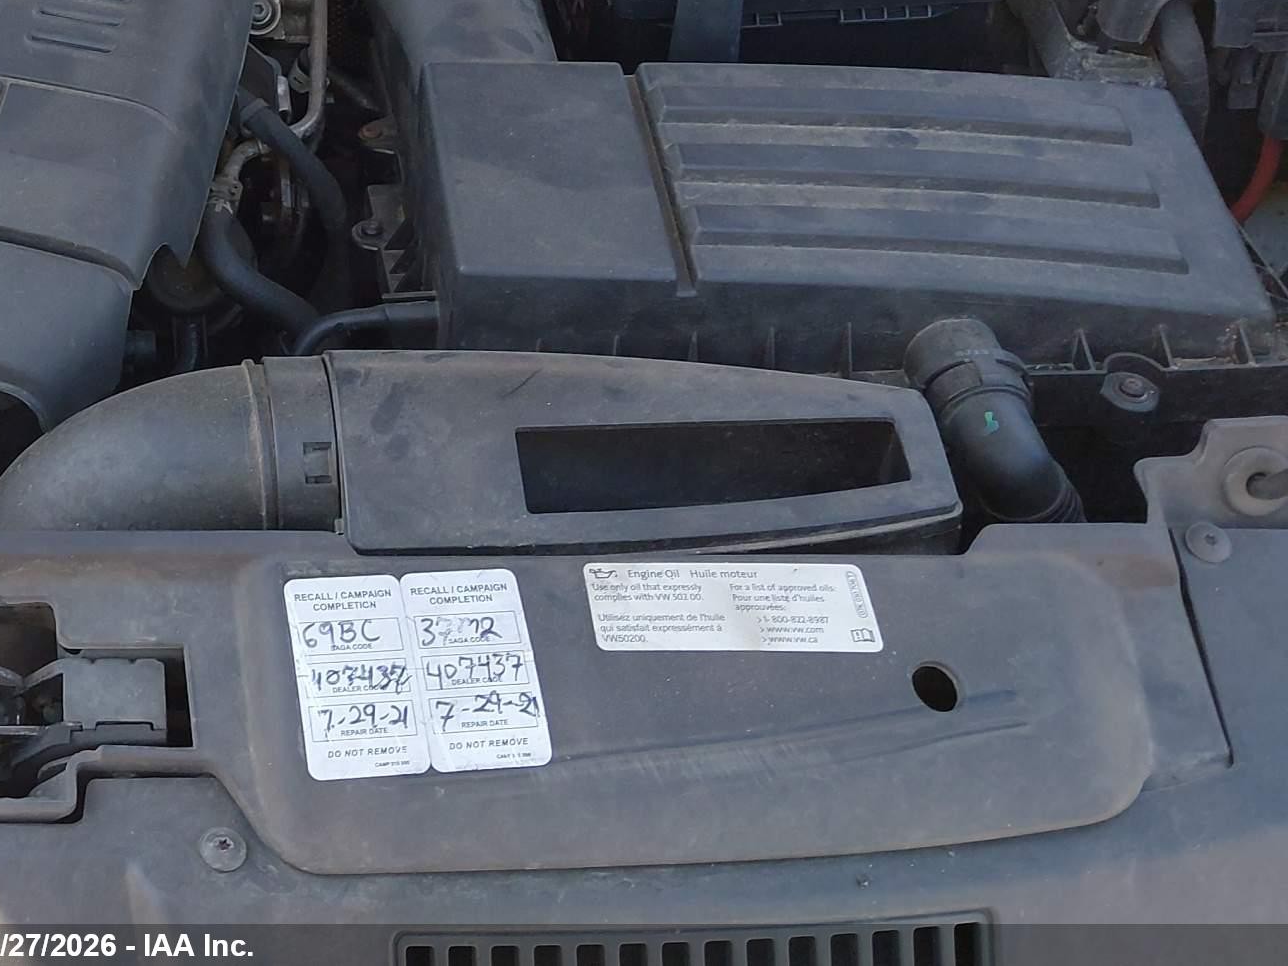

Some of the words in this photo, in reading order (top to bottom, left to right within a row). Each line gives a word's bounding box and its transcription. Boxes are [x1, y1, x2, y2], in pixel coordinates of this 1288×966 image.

[628, 570, 663, 580] Engine
[665, 570, 680, 579] Oil
[690, 570, 717, 578] Huile
[720, 570, 757, 578] moteur
[410, 586, 448, 595] RECALL
[457, 583, 507, 594] CAMPAIGN
[610, 584, 628, 592] only
[642, 583, 660, 591] that
[662, 583, 702, 592] expressly
[729, 583, 743, 591] For
[752, 583, 765, 591] list
[767, 583, 776, 591] of
[777, 584, 817, 593] approved
[294, 592, 332, 602] RECALL
[340, 589, 391, 599] CAMPAIGN
[430, 594, 493, 605] COMPLETION
[594, 593, 633, 602] complies
[634, 593, 653, 601] with
[732, 594, 752, 602] Pour
[313, 601, 376, 611] COMPLETION
[632, 614, 684, 623] uniquement
[600, 624, 613, 633] qui
[426, 653, 523, 690] 407437
[452, 677, 480, 685] DEALER
[333, 685, 361, 693] DEALER
[489, 738, 528, 746] REMOVE
[328, 750, 341, 758] DO
[345, 749, 363, 757] NOT
[368, 746, 407, 755] REMOVE
